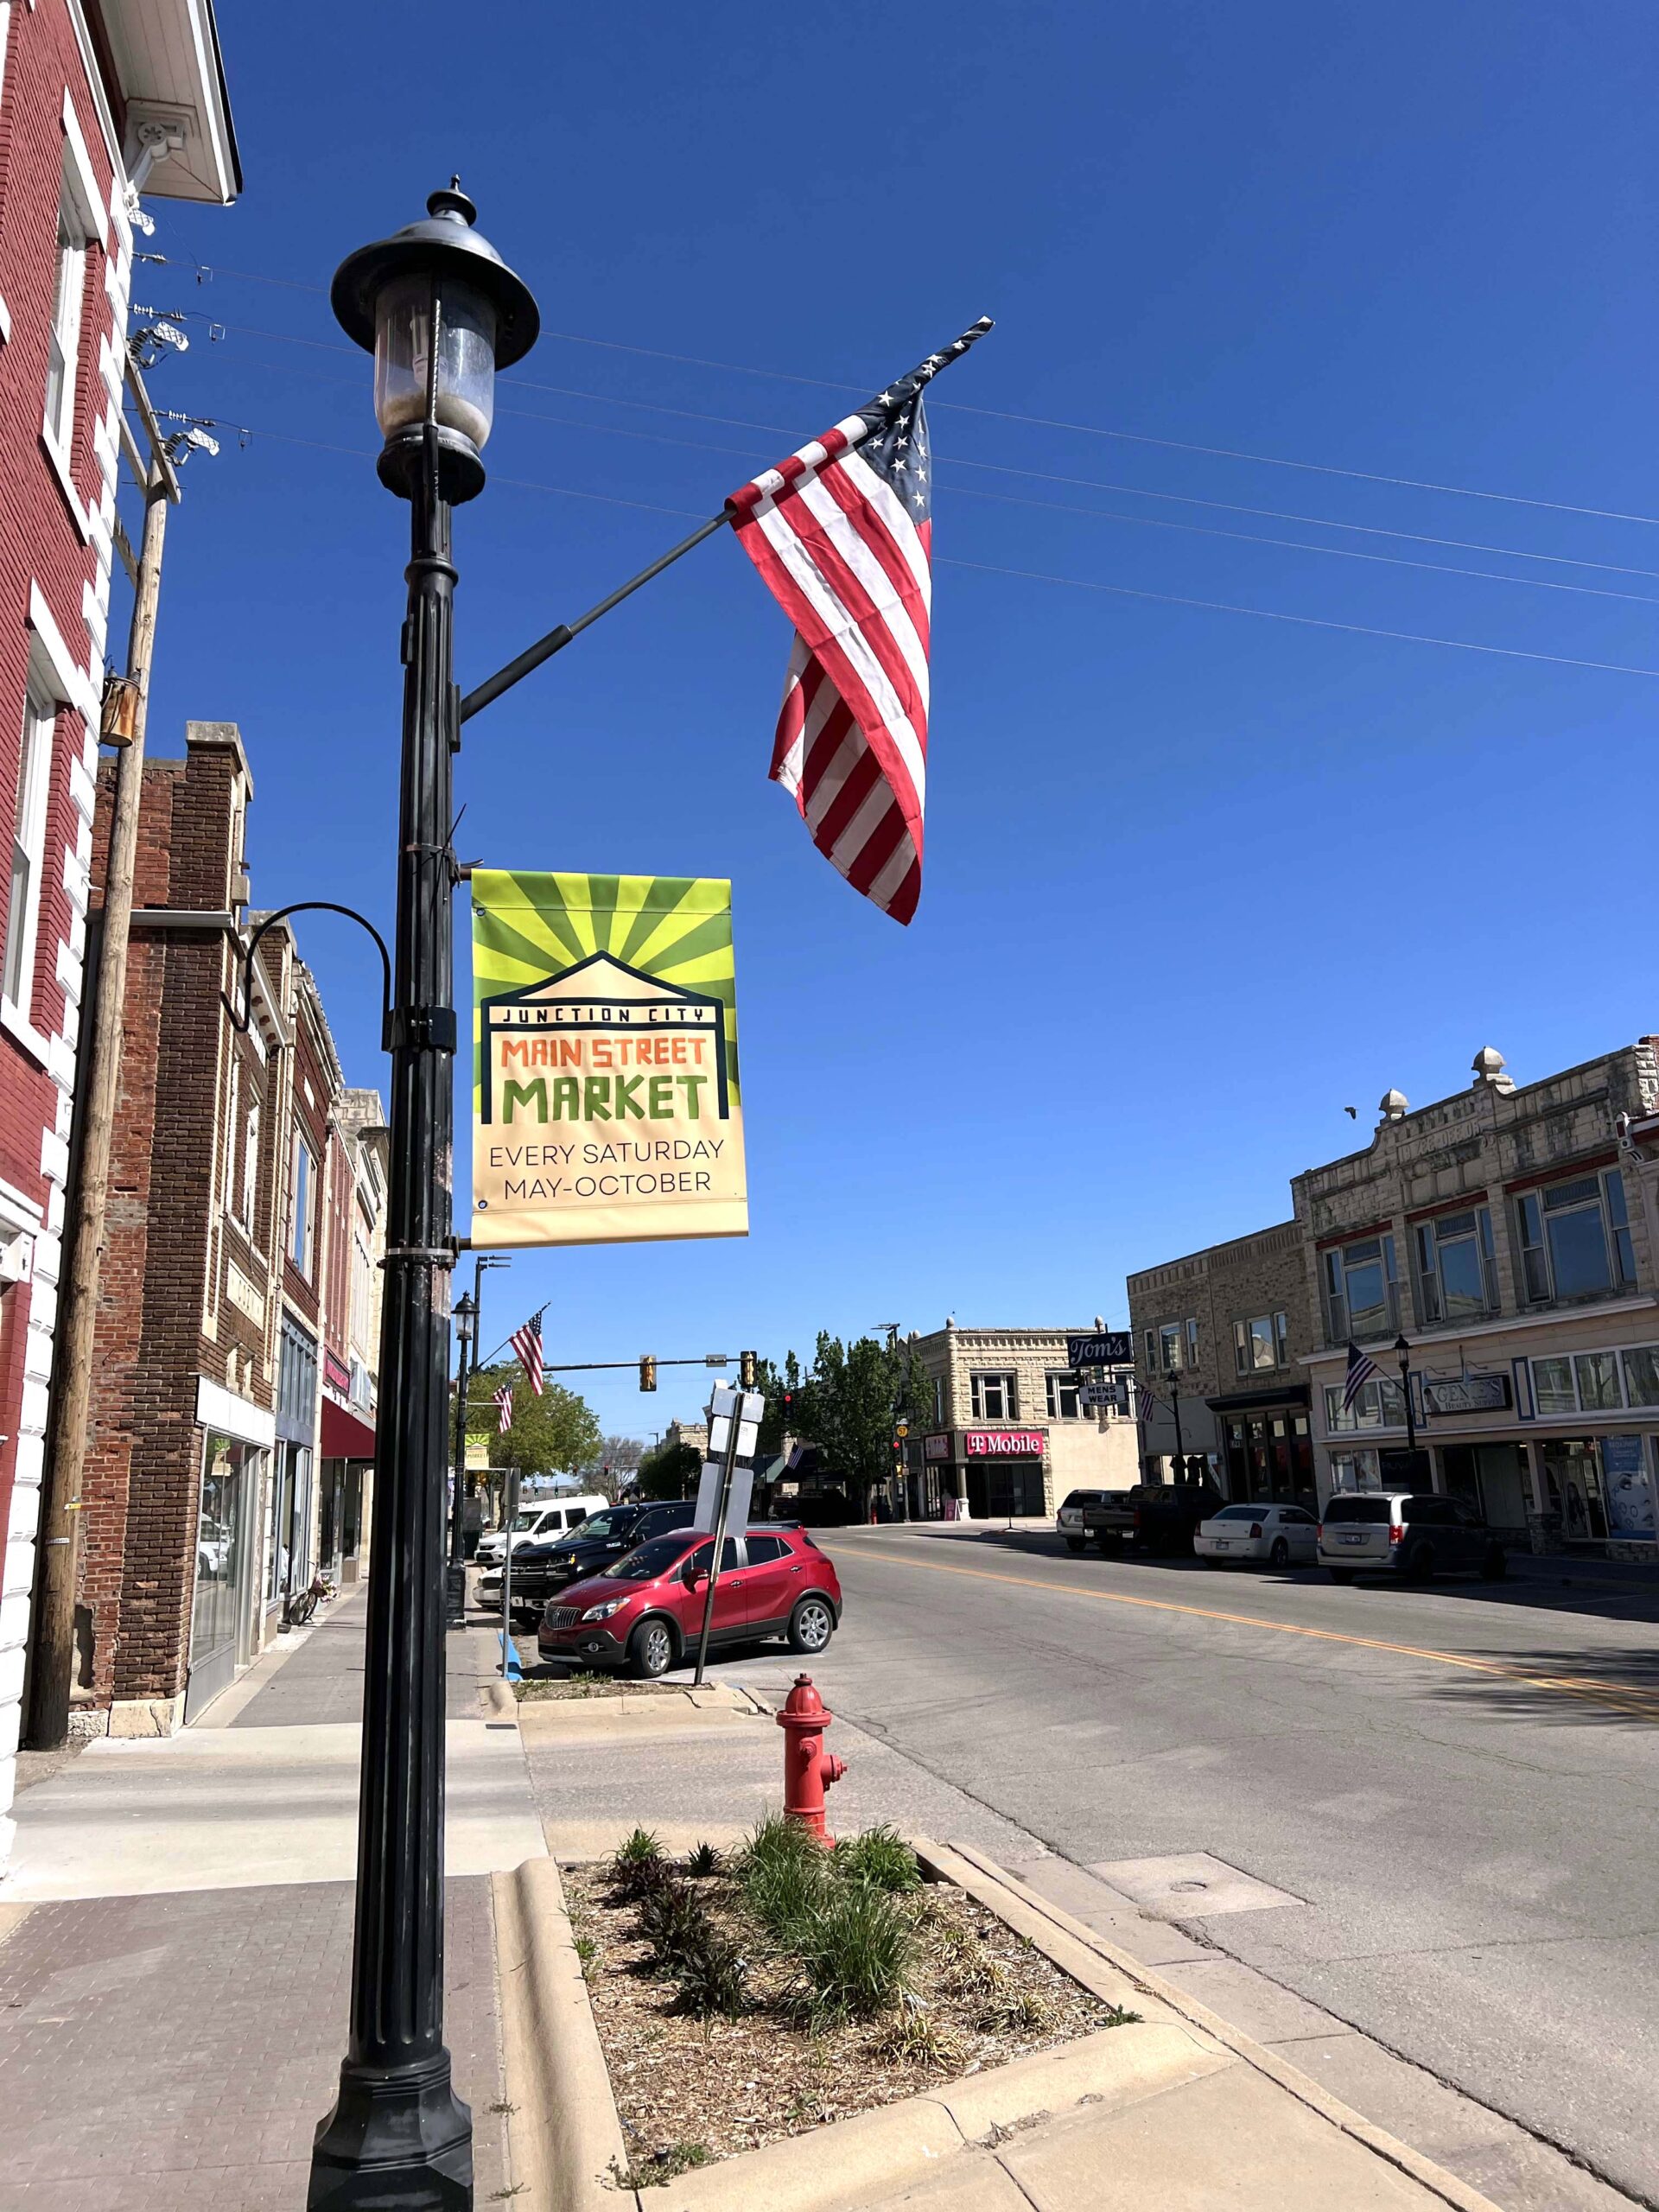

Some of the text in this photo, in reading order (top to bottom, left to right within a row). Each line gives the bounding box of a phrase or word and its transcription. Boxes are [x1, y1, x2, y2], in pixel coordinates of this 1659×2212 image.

[502, 1007, 704, 1023] JUNCTION CITY
[501, 1037, 707, 1067] MAIN STREET
[502, 1074, 708, 1124] MARKET
[490, 1139, 725, 1167] EVERY SATURDAY
[505, 1171, 711, 1200] MAY-OCTOBER
[1071, 1336, 1127, 1365] Tom's
[1088, 1385, 1116, 1395] MENS
[1089, 1395, 1117, 1403] WEAR
[987, 1434, 1039, 1452] Mobile
